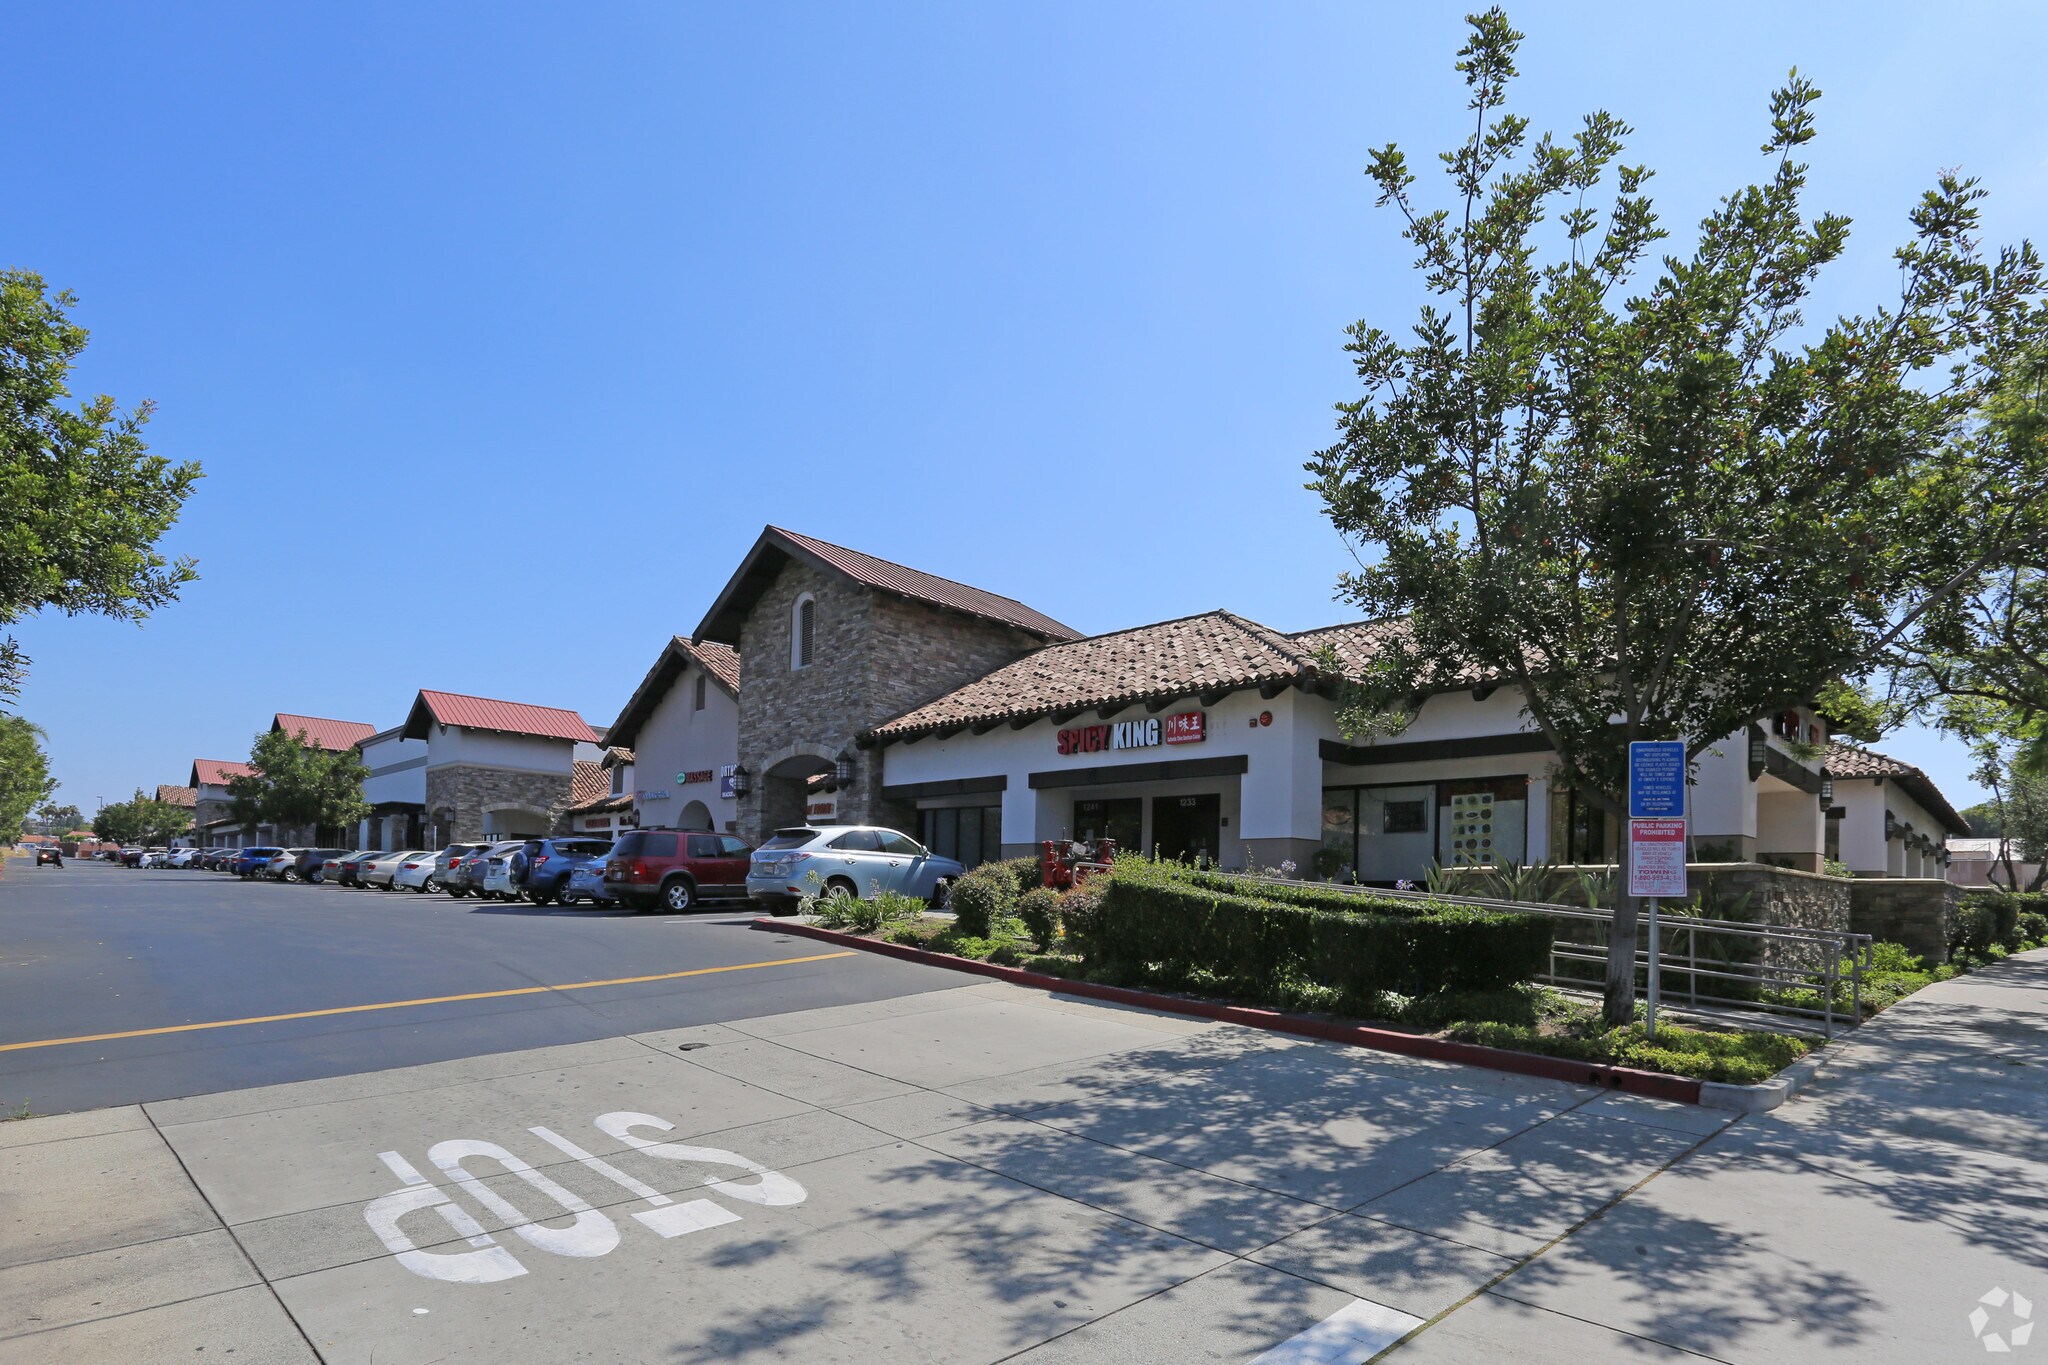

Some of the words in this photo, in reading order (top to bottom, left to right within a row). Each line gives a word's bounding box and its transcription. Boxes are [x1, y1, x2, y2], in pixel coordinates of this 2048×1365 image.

[1168, 716, 1200, 735] 川味王
[1058, 725, 1109, 755] SPICY
[1114, 718, 1160, 749] KING
[683, 770, 713, 783] MASSAGE
[1083, 803, 1099, 811] 1241
[1180, 798, 1196, 807] 1233
[363, 1111, 808, 1284] STOP
